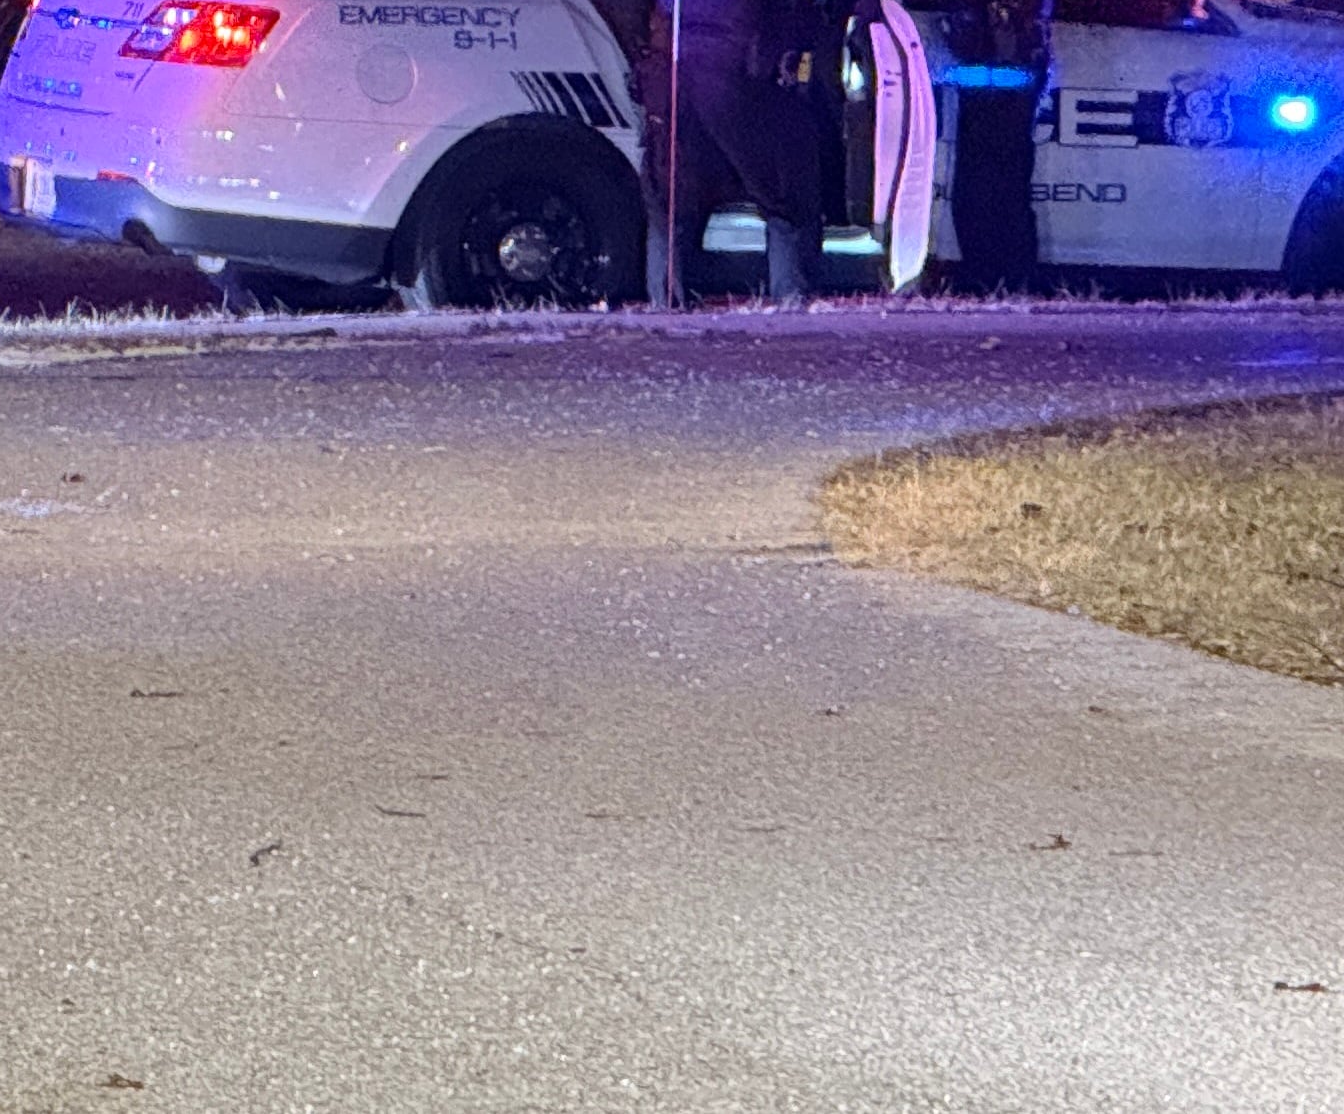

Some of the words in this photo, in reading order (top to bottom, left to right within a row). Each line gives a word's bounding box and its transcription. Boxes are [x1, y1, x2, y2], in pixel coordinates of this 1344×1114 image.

[338, 4, 521, 27] EMERGENCY
[454, 29, 518, 50] 9-1-1
[1031, 182, 1127, 203] BEND
